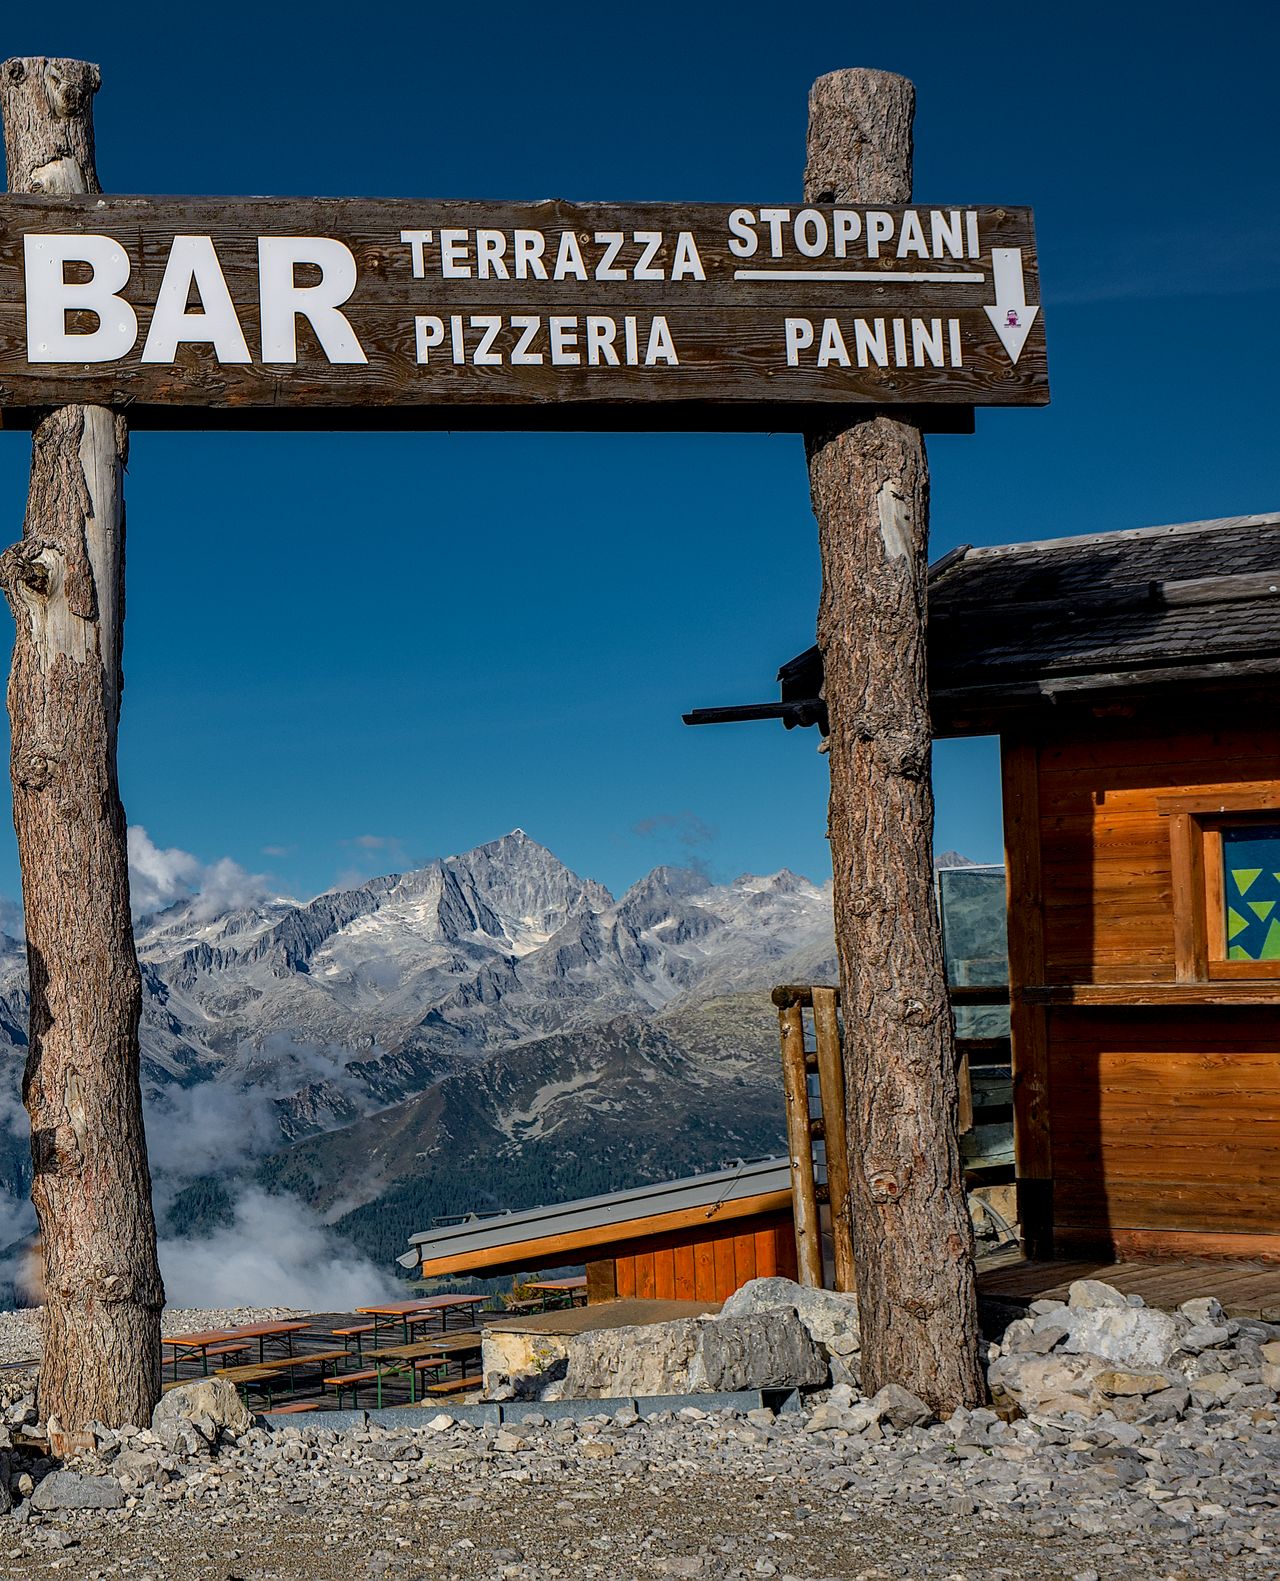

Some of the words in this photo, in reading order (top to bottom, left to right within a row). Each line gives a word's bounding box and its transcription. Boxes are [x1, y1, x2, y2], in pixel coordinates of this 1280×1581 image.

[401, 229, 707, 282] TERRAZZA
[727, 207, 980, 260] STOPPANI
[24, 233, 370, 364] BAR
[414, 315, 680, 366] PIZZERIA
[785, 317, 963, 368] PANINI
